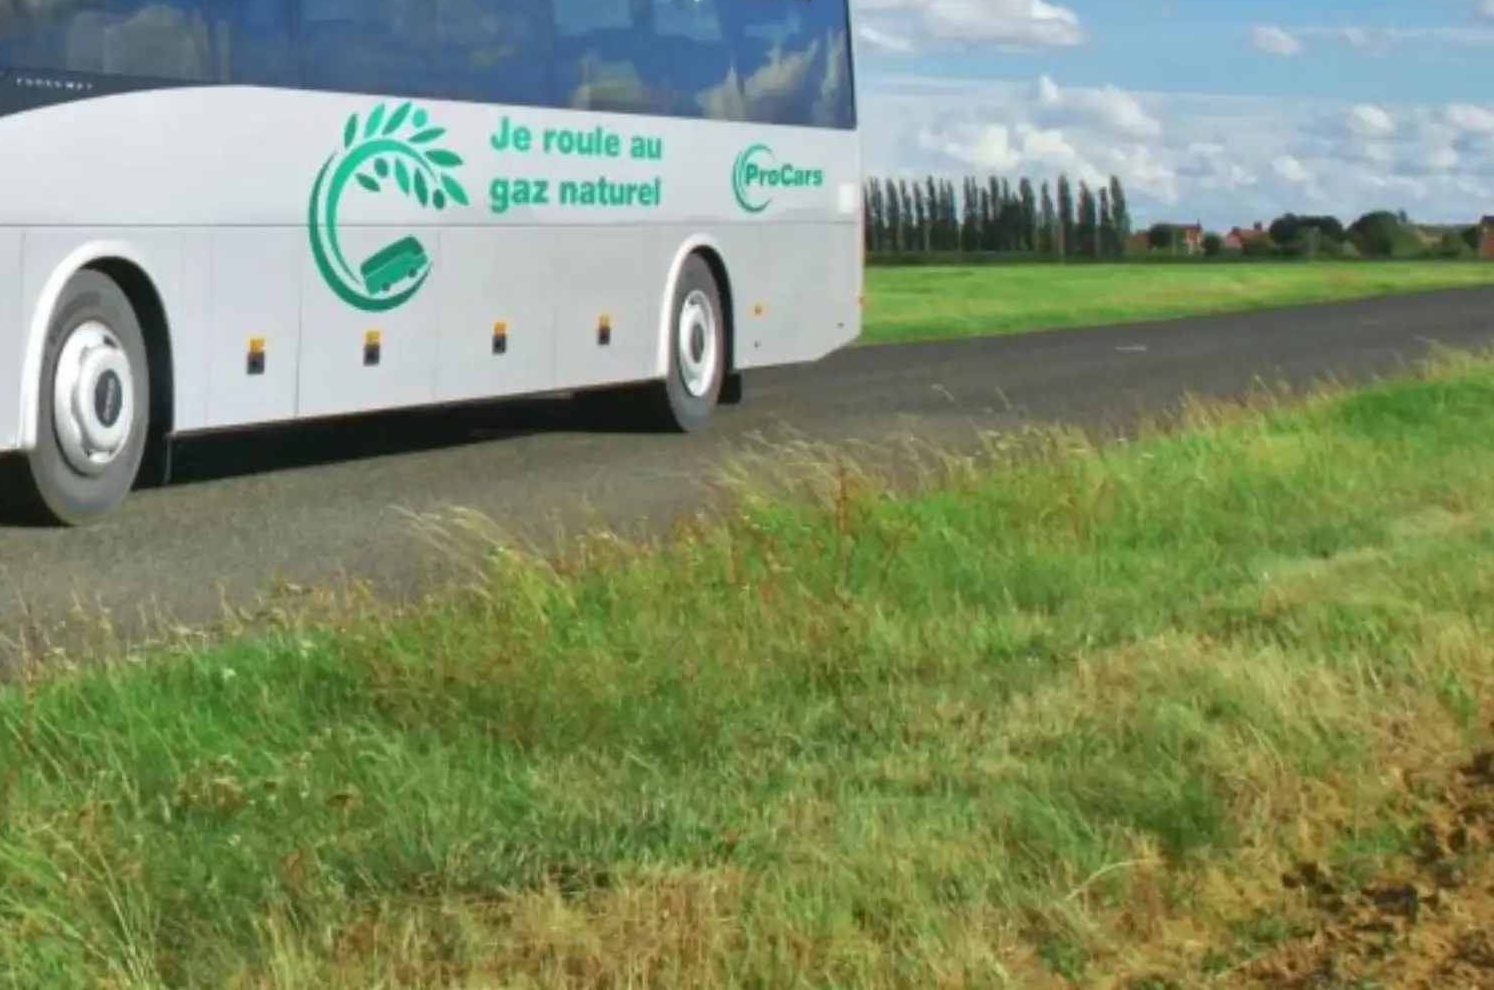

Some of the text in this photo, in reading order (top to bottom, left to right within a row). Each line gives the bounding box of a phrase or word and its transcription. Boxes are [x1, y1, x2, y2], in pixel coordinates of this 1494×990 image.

[490, 115, 662, 160] Je roule au
[745, 162, 823, 187] ProCars
[490, 175, 661, 214] gaz naturel
